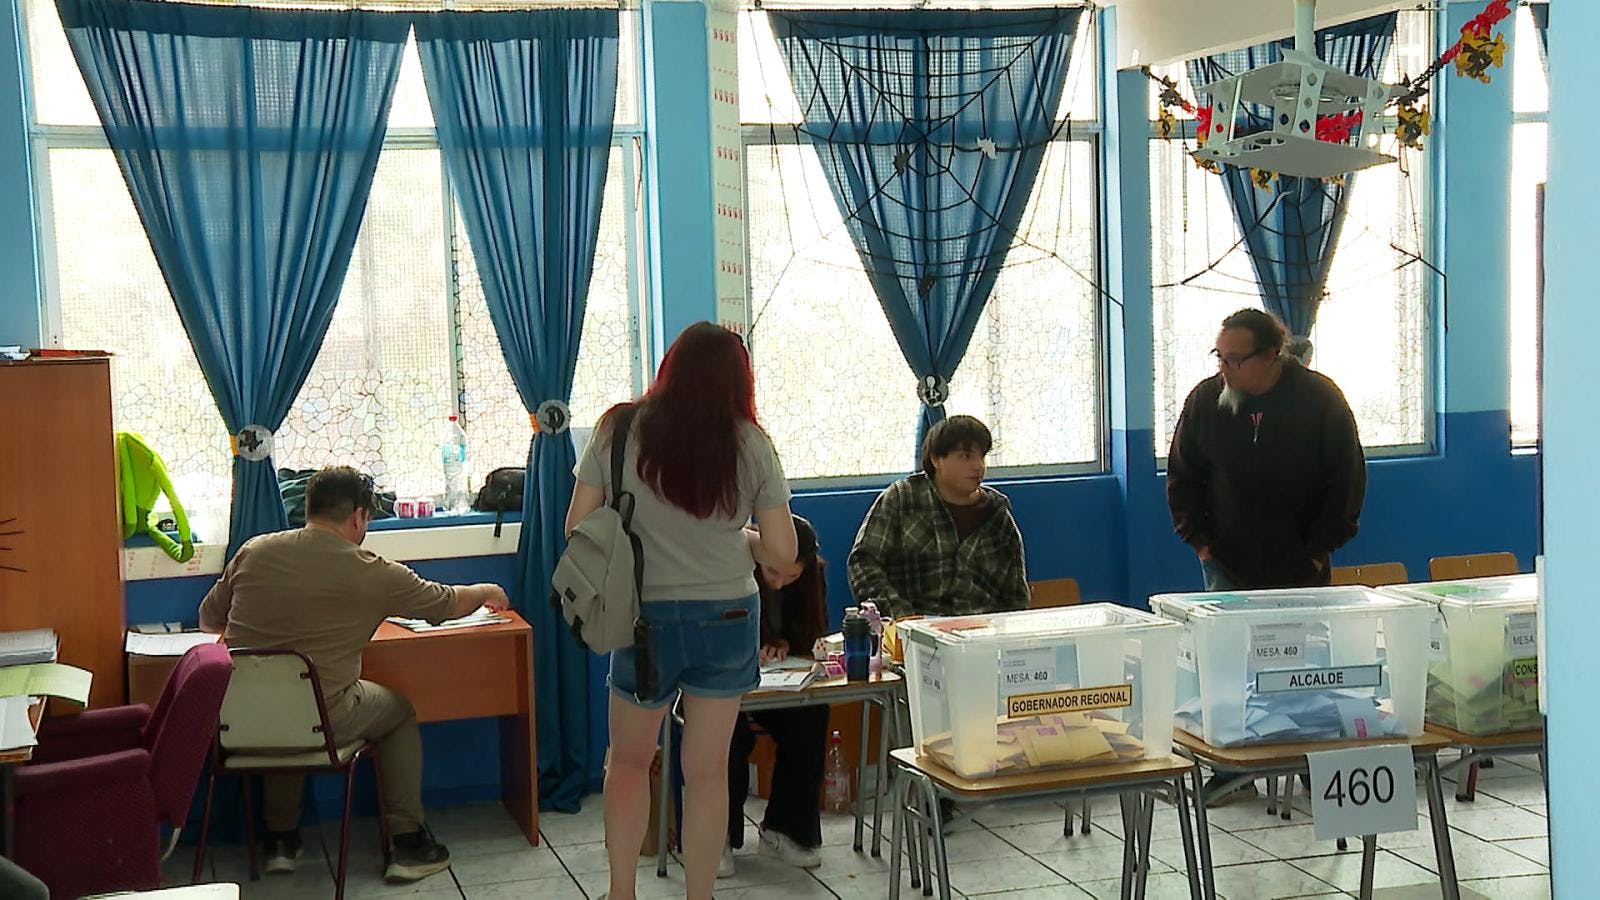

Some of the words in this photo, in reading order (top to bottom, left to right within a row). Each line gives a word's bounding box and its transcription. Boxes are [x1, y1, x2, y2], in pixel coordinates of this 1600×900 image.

[1284, 646, 1298, 656] 460
[1034, 671, 1048, 681] 460
[1289, 672, 1343, 687] ALCALDE
[1012, 695, 1078, 712] GOBERNADOR
[1080, 691, 1128, 706] REGIONAL
[1323, 765, 1395, 808] 460
